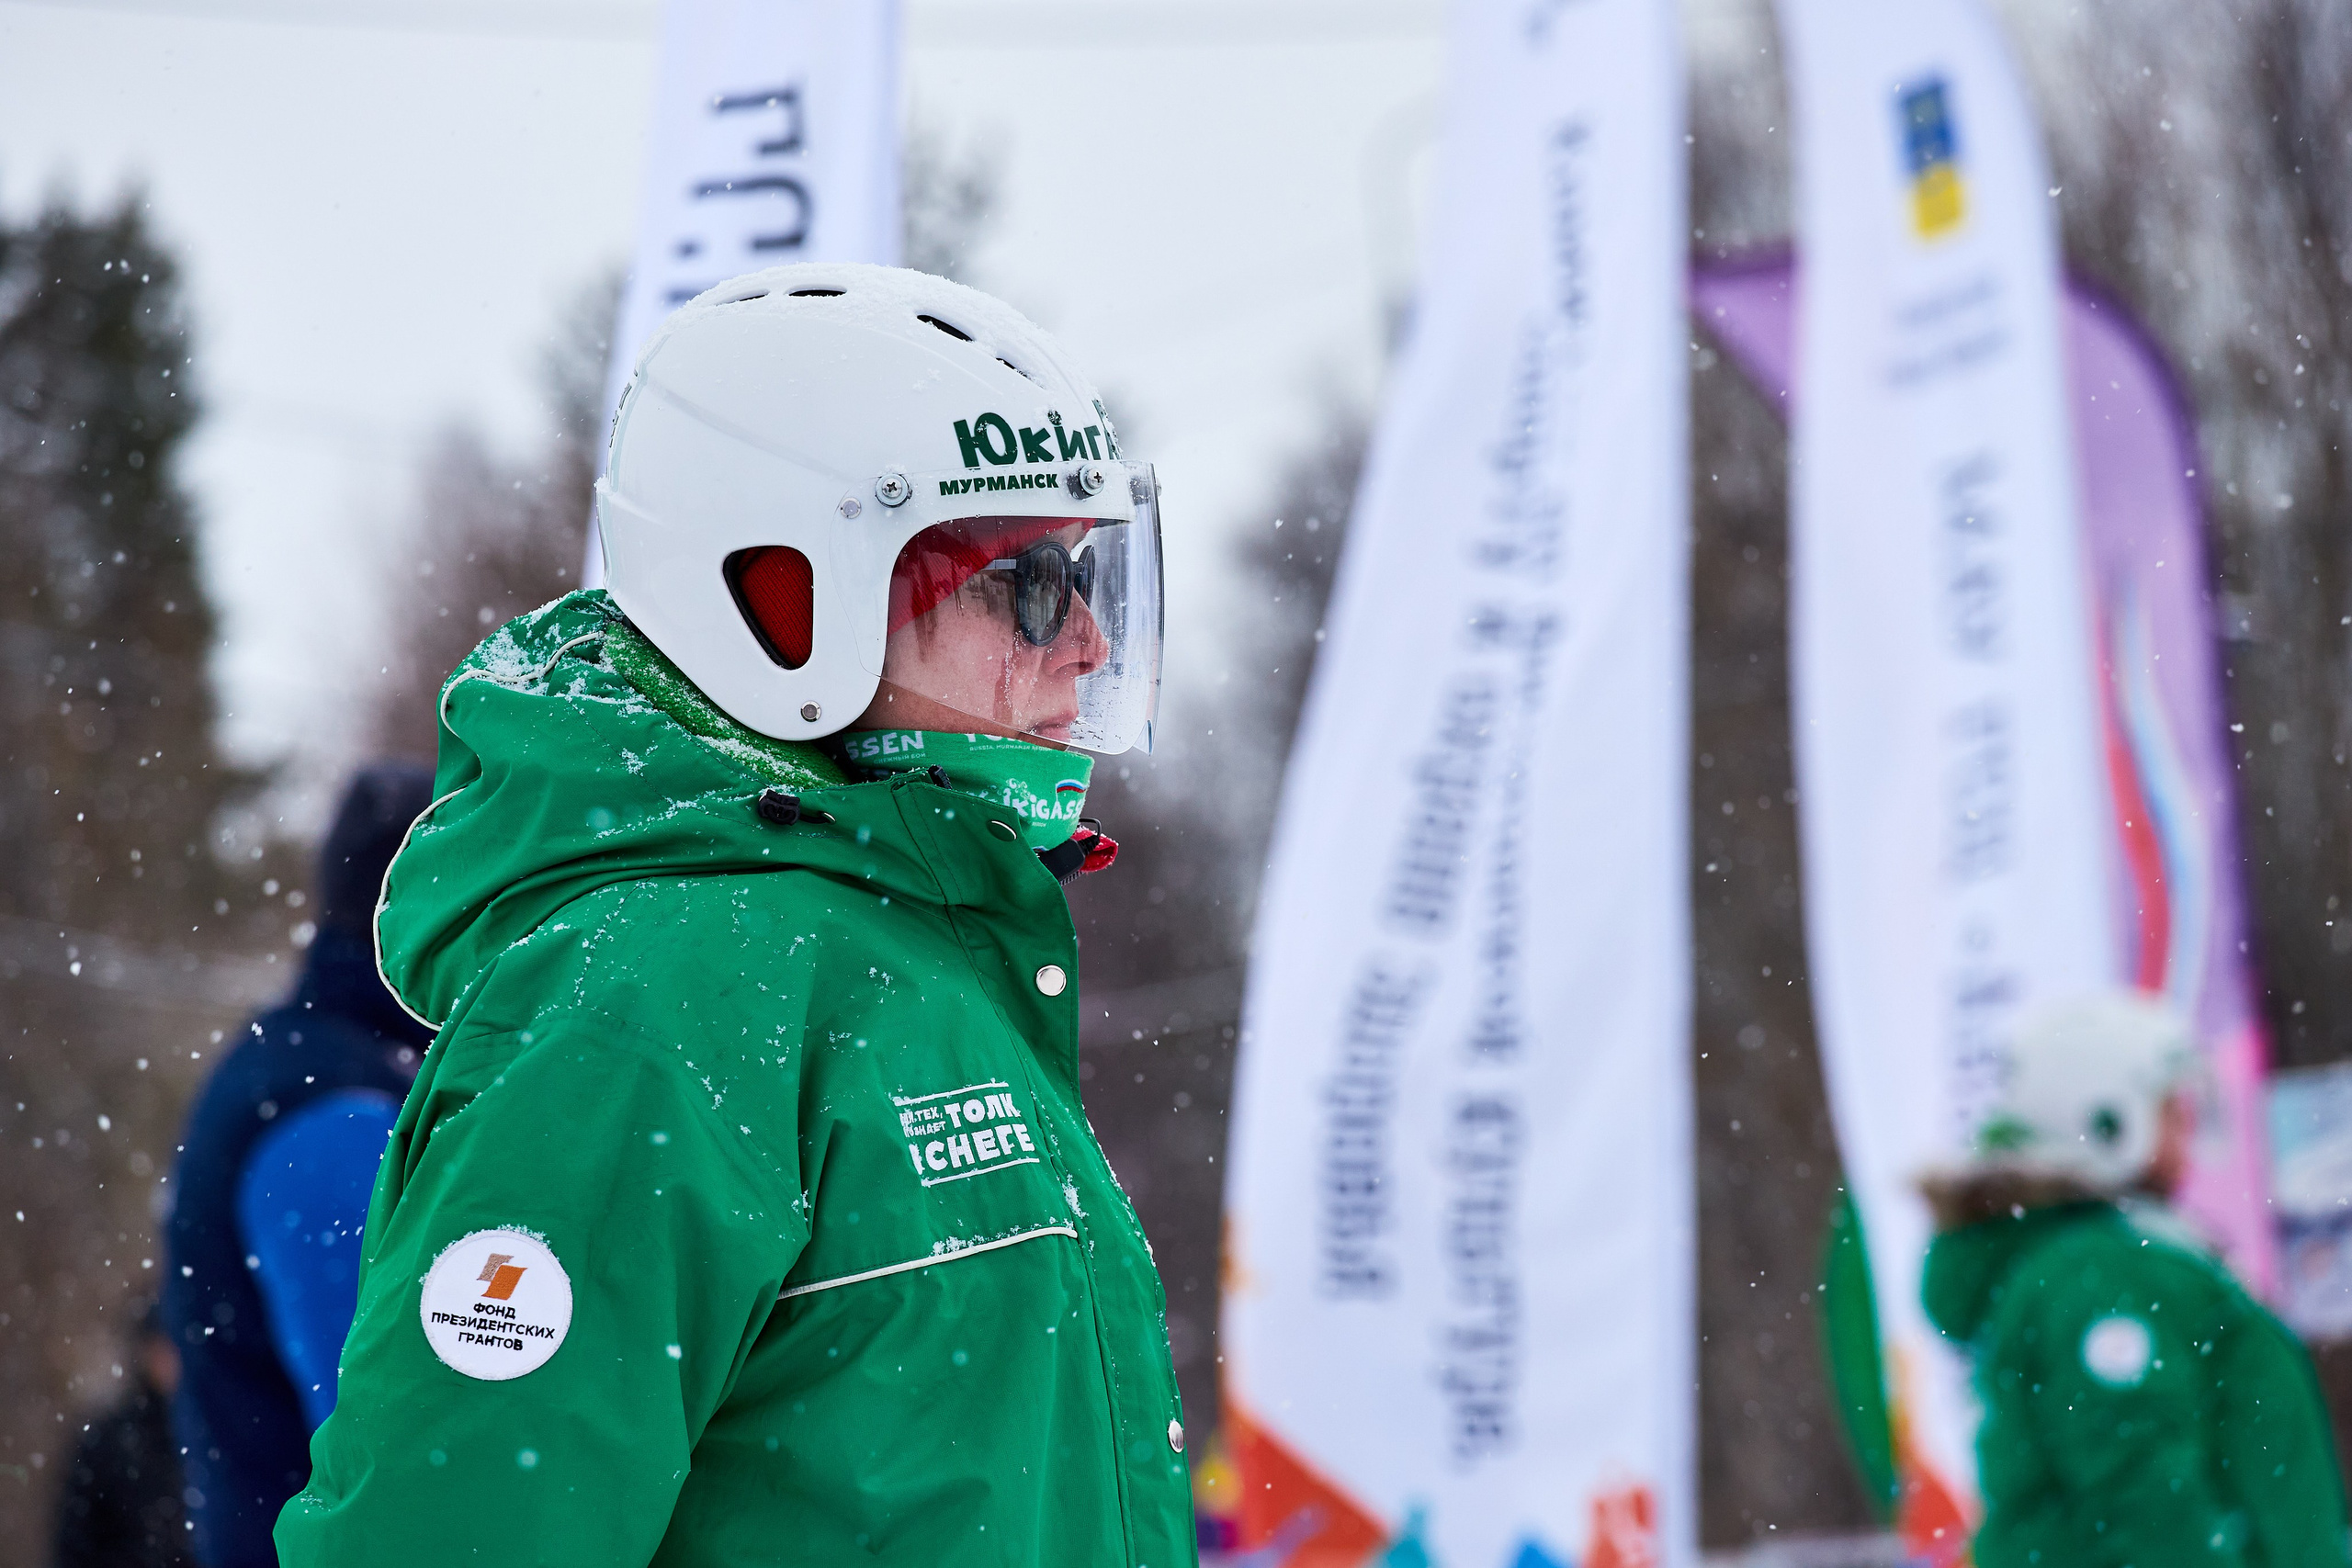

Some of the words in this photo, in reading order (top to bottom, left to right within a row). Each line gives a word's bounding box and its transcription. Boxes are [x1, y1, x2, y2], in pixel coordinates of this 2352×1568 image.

[939, 473, 1059, 497] МУРМАНСК
[943, 1093, 1022, 1129] ТОЛК
[924, 1123, 1036, 1171] СНЕГЕ
[473, 1302, 516, 1320] ФОНД
[431, 1312, 556, 1339] ПРЕЗИДЕНТСКИХ
[458, 1332, 524, 1351] ГРАНТОВ
